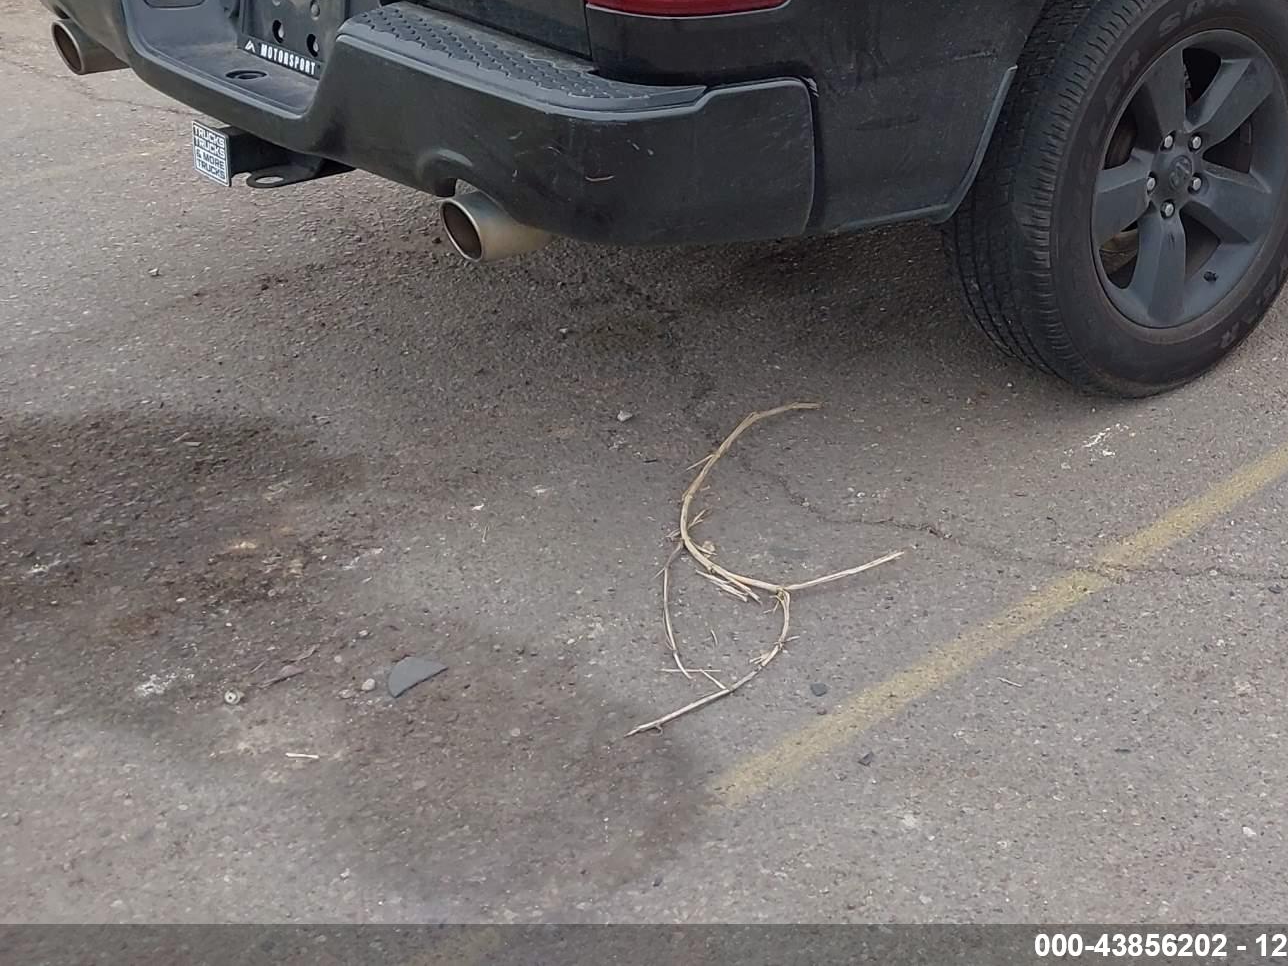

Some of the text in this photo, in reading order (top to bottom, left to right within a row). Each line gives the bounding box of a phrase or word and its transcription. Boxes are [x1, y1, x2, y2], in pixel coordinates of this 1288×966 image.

[260, 43, 316, 76] MOTORSPORT
[193, 124, 225, 149] TRUCKS
[194, 135, 226, 159] TRUCKS
[196, 147, 225, 171] & MORE
[198, 159, 226, 180] TRUCKS
